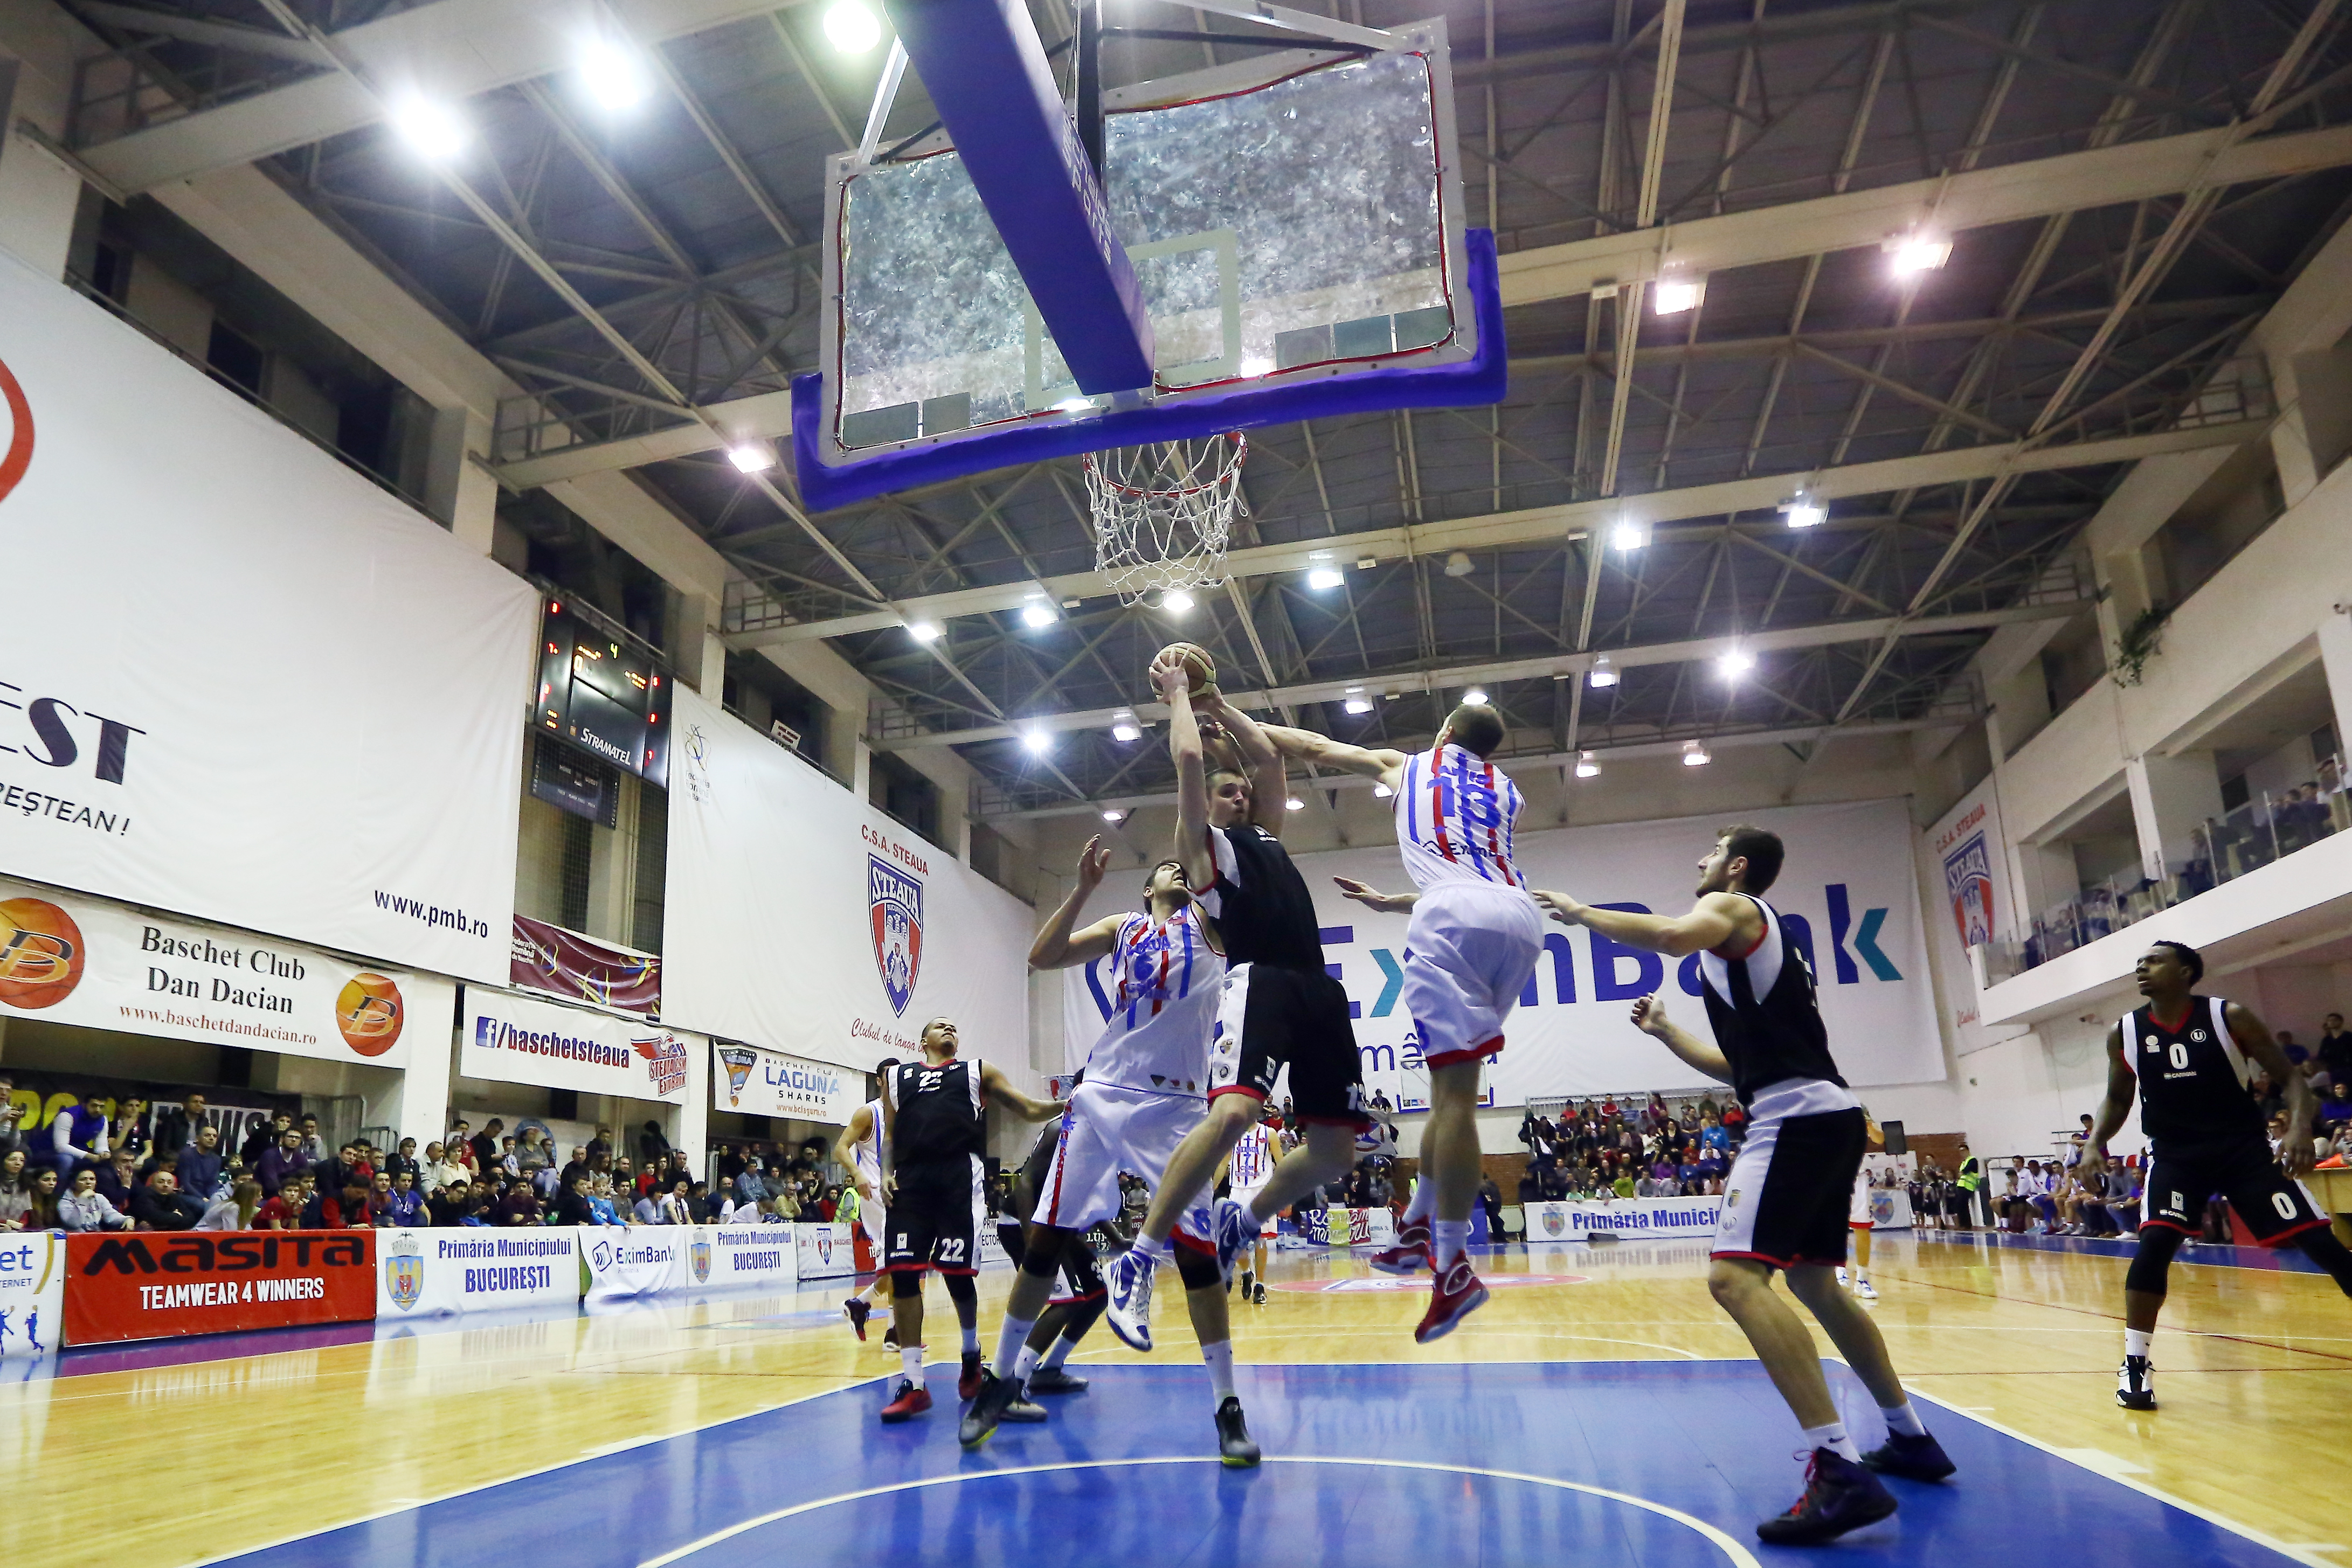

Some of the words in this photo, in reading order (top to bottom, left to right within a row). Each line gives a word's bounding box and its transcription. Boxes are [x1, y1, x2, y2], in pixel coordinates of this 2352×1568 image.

[580, 727, 631, 766] STRAMATEL
[862, 824, 890, 853] C.S.A.
[893, 843, 928, 876] STEAUA
[872, 866, 921, 925] STEAUA
[375, 890, 488, 938] www.pmb.ro
[141, 925, 241, 968] Baschet
[250, 950, 305, 981] Club
[148, 966, 199, 998] Dan
[212, 977, 293, 1014] Dacian
[120, 1005, 317, 1045] www.baschetdandacian.ro
[883, 1030, 893, 1044] de
[765, 1058, 810, 1071] BASCHET
[2169, 1043, 2189, 1070] 0
[765, 1066, 840, 1096] LAGUNA
[1573, 1211, 1649, 1230] Primăria
[2271, 1192, 2298, 1220] 0
[439, 1239, 494, 1258] Primăria
[497, 1238, 571, 1257] Municipiului
[718, 1231, 749, 1246] Primăria
[751, 1231, 791, 1245] Municipiului
[939, 1238, 965, 1262] 22
[140, 1282, 238, 1310] TEAMWEAR
[241, 1280, 253, 1303] 4
[256, 1277, 324, 1303] WINNERS
